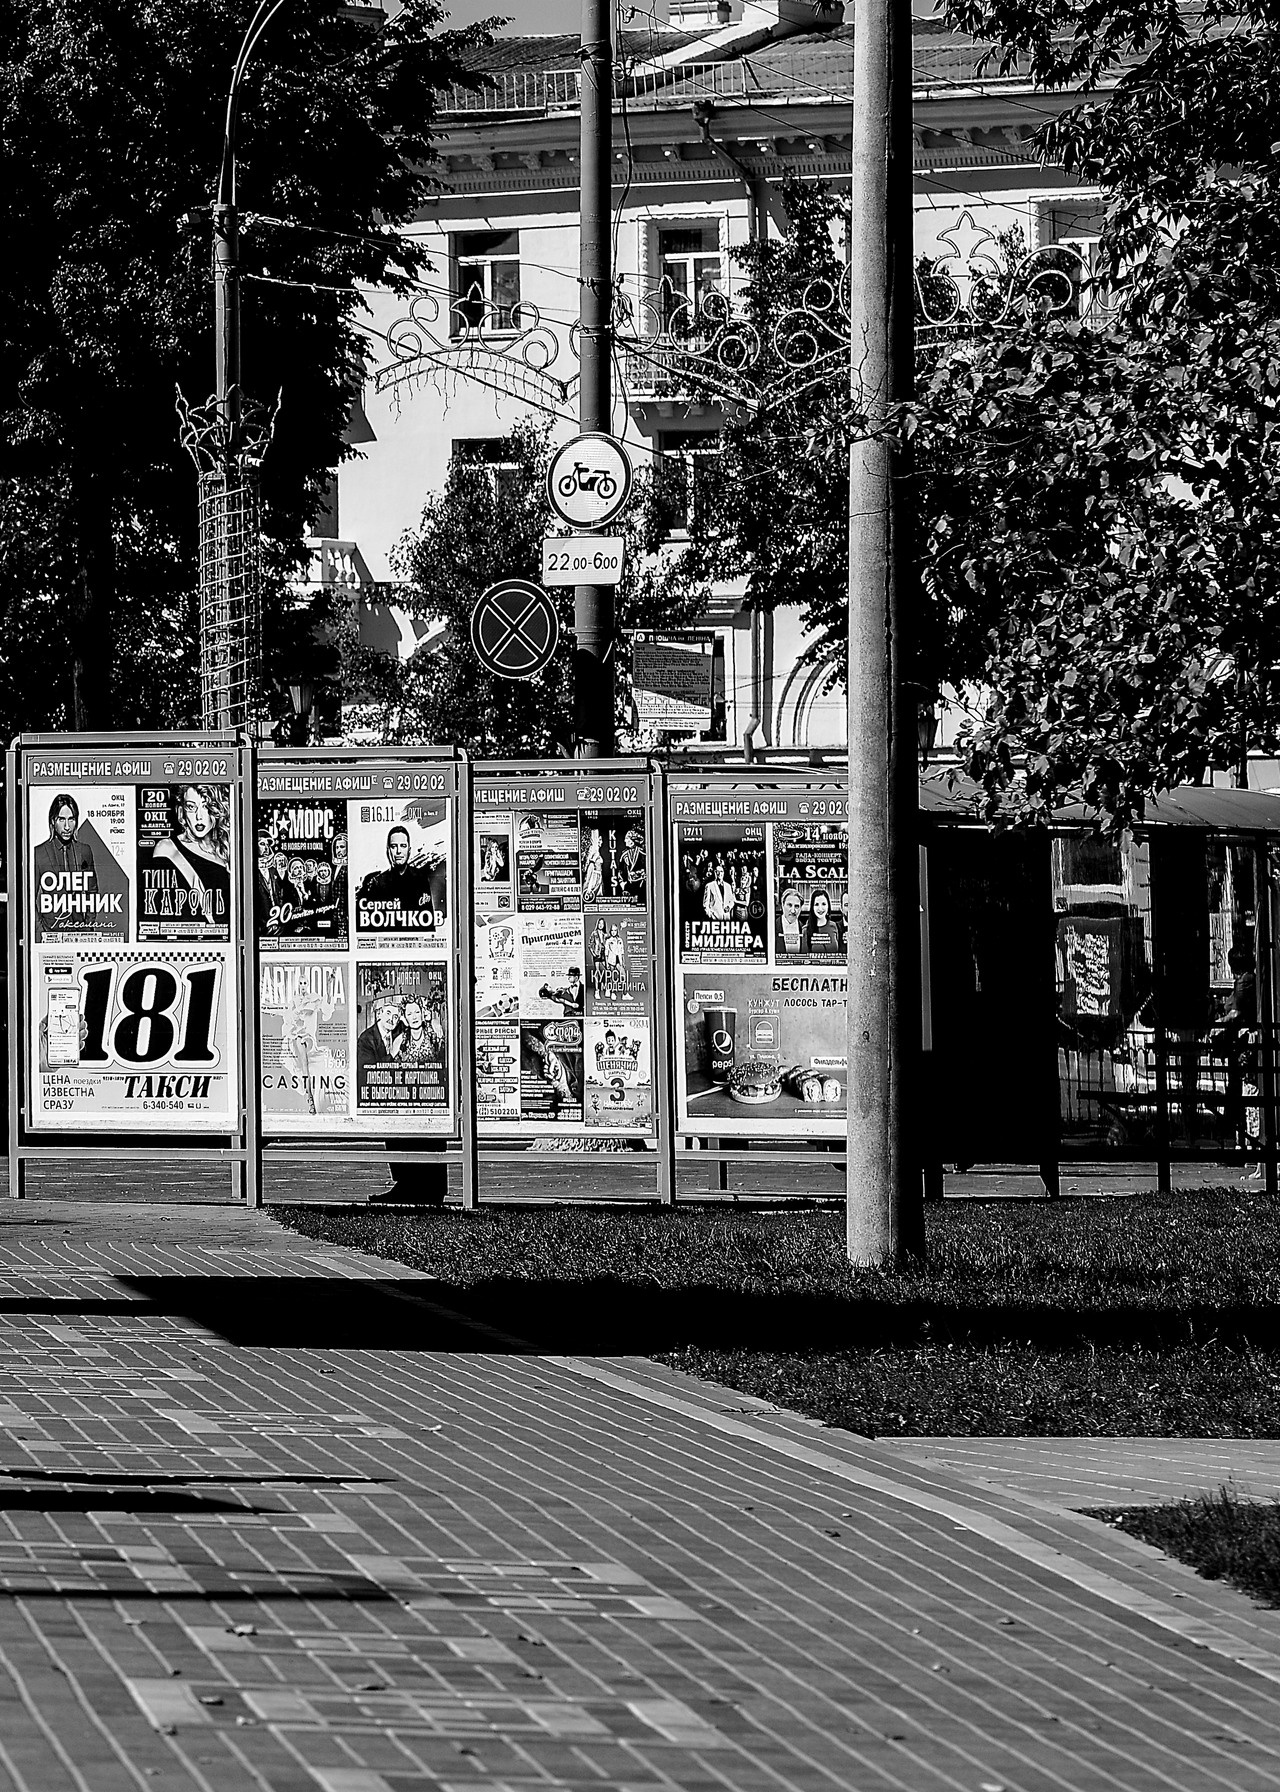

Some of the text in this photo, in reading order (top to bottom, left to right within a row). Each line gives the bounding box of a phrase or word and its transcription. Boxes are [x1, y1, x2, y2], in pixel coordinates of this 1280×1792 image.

[33, 760, 227, 779] РАЗМЕЩЕНИЕ АФИШ 29 02 02
[258, 775, 445, 794] РАЗМЕЩЕНИЕ АФИШ 29 02 02
[111, 794, 125, 802] ОКЦ
[147, 791, 165, 802] 20
[474, 787, 637, 806] МЕЩЕНИЕ АФИШ 29 02 02
[87, 810, 125, 818] 18 НОЯБРЯ
[371, 806, 395, 822] 16.11
[676, 801, 750, 817] РАЗМЕЩЕНИЕ
[753, 801, 787, 815] АФИШ
[812, 801, 826, 815] 29
[829, 801, 842, 815] 02
[144, 811, 168, 823] ОКЦ
[683, 827, 703, 836] 17/11
[805, 827, 848, 842] 14 ноябр
[608, 829, 618, 896] KUTAISI
[778, 865, 848, 878] LA SCAL
[40, 871, 94, 892] ОЛЕГ
[40, 893, 123, 913] ВИННИК
[144, 889, 225, 916] КАРОЛЬ
[359, 897, 401, 912] Сергей
[266, 902, 293, 927] 20
[359, 910, 444, 927] ВОЛЧКОВ
[691, 921, 751, 935] ГЛЕННА
[521, 930, 582, 945] Приглашаем
[691, 935, 764, 948] МИЛЛЕРА
[396, 971, 421, 986] НОЯБРЯ
[591, 970, 629, 983] КУРСЫ
[600, 982, 646, 991] МОДЕЛИНГА
[772, 978, 848, 992] БЕСПЛАТН
[748, 999, 780, 1007] КУНЖУТ
[784, 998, 848, 1007] ЛОСОСЬ ТАР-Т
[80, 965, 220, 1064] 181
[603, 1019, 609, 1027] 5
[596, 1060, 639, 1071] ЩЕНЯЧИЙ
[712, 1057, 734, 1070] pepsi
[813, 1058, 847, 1066] Филадельфи
[43, 1075, 70, 1086] ЦЕНА
[262, 1075, 346, 1089] CASTING
[366, 1071, 393, 1084] ЛЮБОВЬ
[394, 1071, 403, 1084] НЕ
[43, 1087, 95, 1097] ИЗВЕСТНА
[124, 1075, 212, 1098] ТАКСИ
[361, 1086, 445, 1100] НЕ ВЫБРОСИШЬ В ОКОШКО
[610, 1077, 626, 1101] 3
[43, 1100, 74, 1110] СРАЗУ
